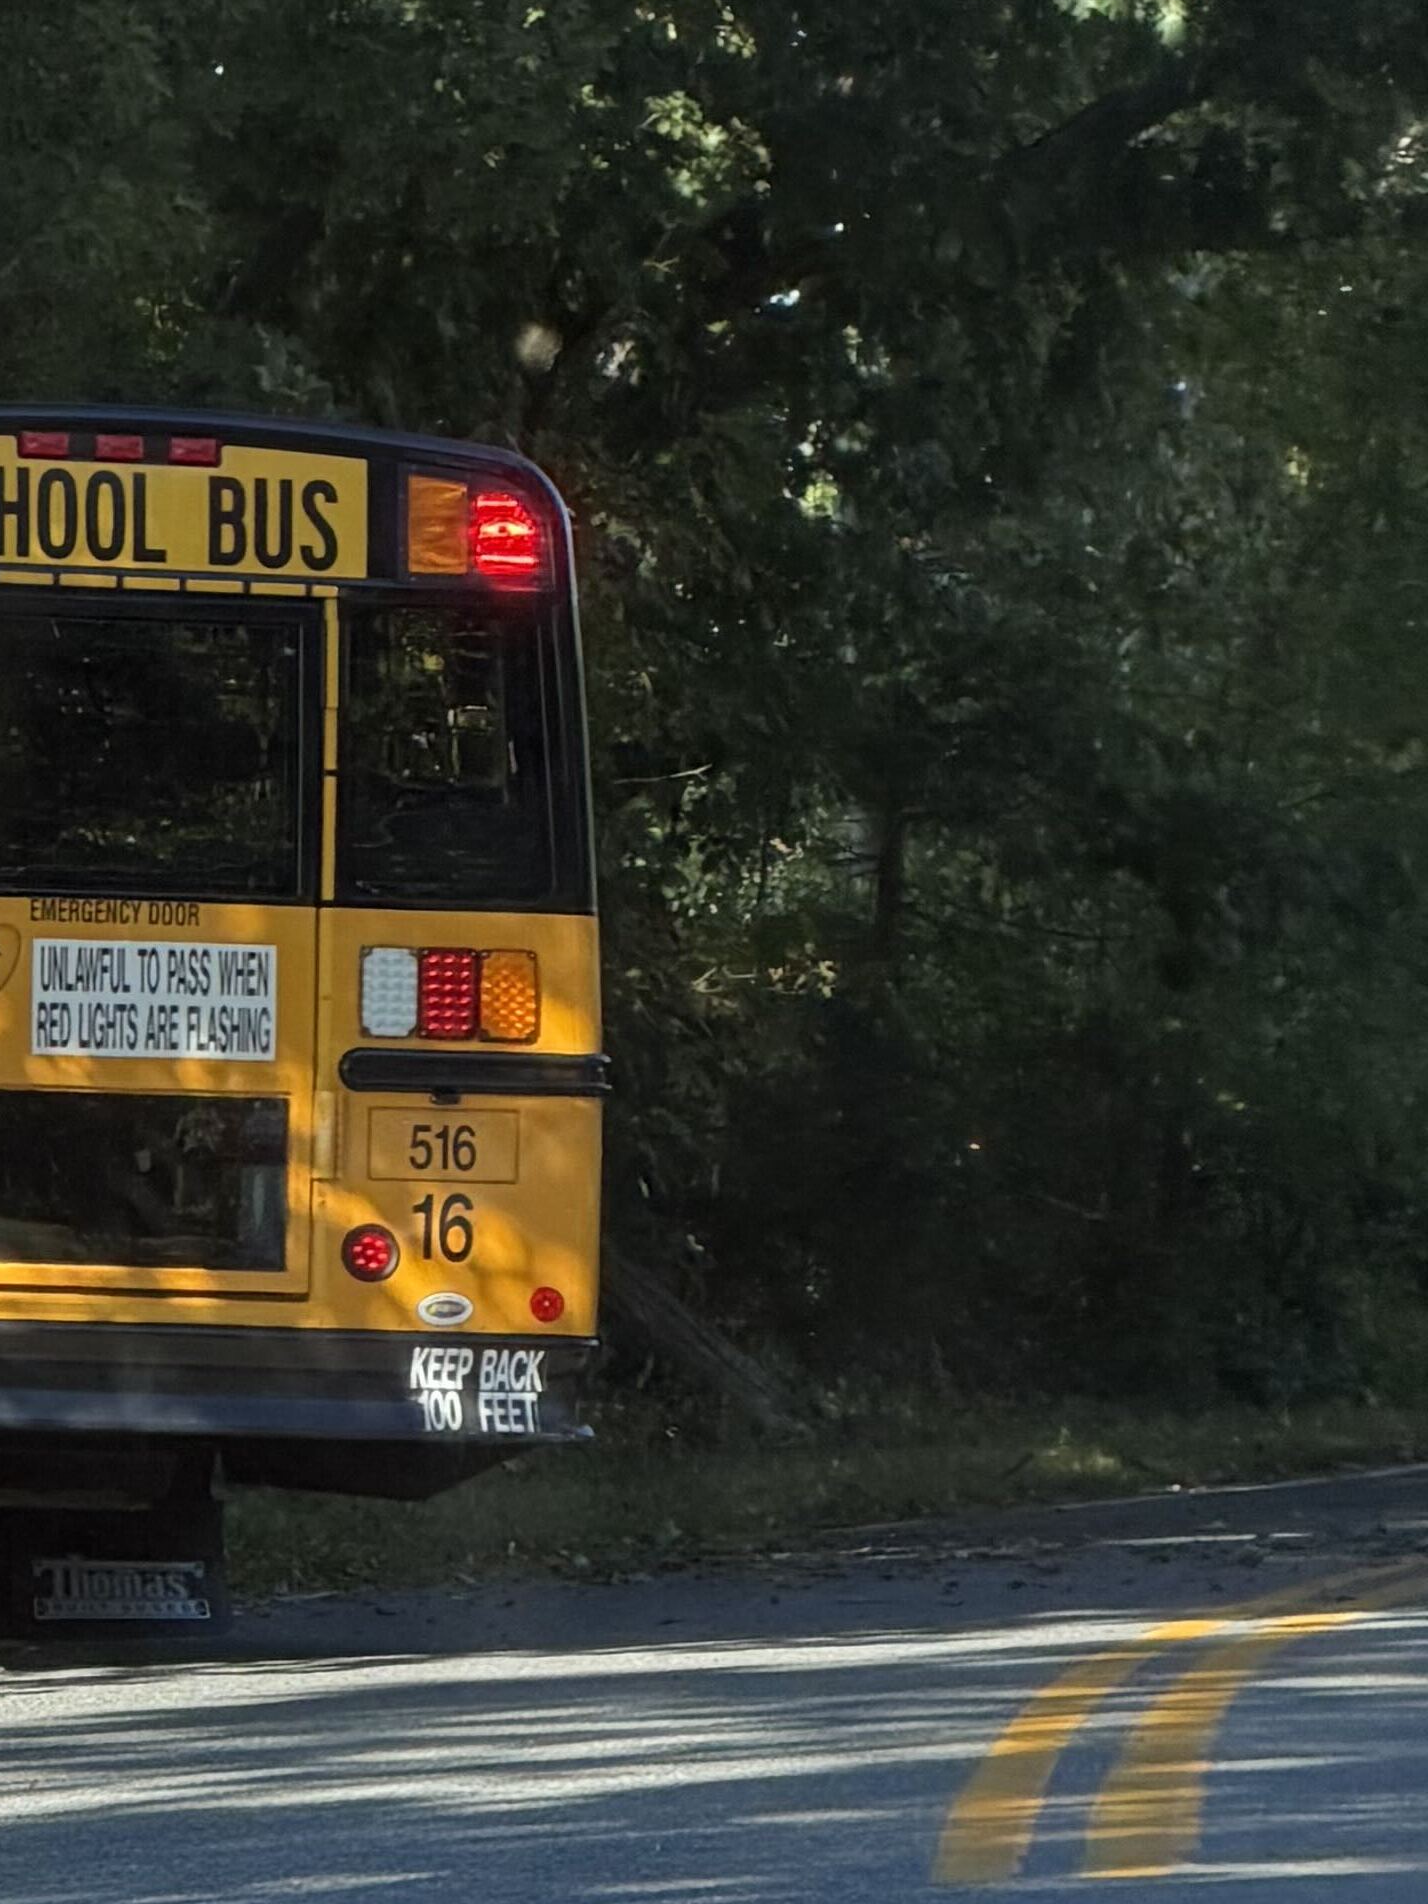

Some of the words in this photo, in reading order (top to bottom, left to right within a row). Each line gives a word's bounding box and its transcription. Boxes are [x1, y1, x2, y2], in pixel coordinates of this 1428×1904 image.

[208, 475, 339, 572] BUS
[30, 898, 142, 925] EMERGENCY
[148, 903, 200, 927] DOOR
[40, 946, 131, 994] UNLAWFUL
[137, 948, 161, 995] TO
[167, 948, 211, 996] PASS
[218, 951, 270, 997] WHEN
[37, 1002, 72, 1048] RED
[78, 1003, 139, 1051] LIGHTS
[145, 1004, 180, 1051] ARE
[186, 1005, 272, 1054] FLASHING
[409, 1124, 477, 1172] 516
[412, 1192, 474, 1263] 16
[410, 1346, 474, 1391] KEEP
[479, 1349, 546, 1392] BACK
[416, 1389, 464, 1432] 100
[478, 1392, 538, 1433] FEET
[32, 1558, 204, 1599] Thomas
